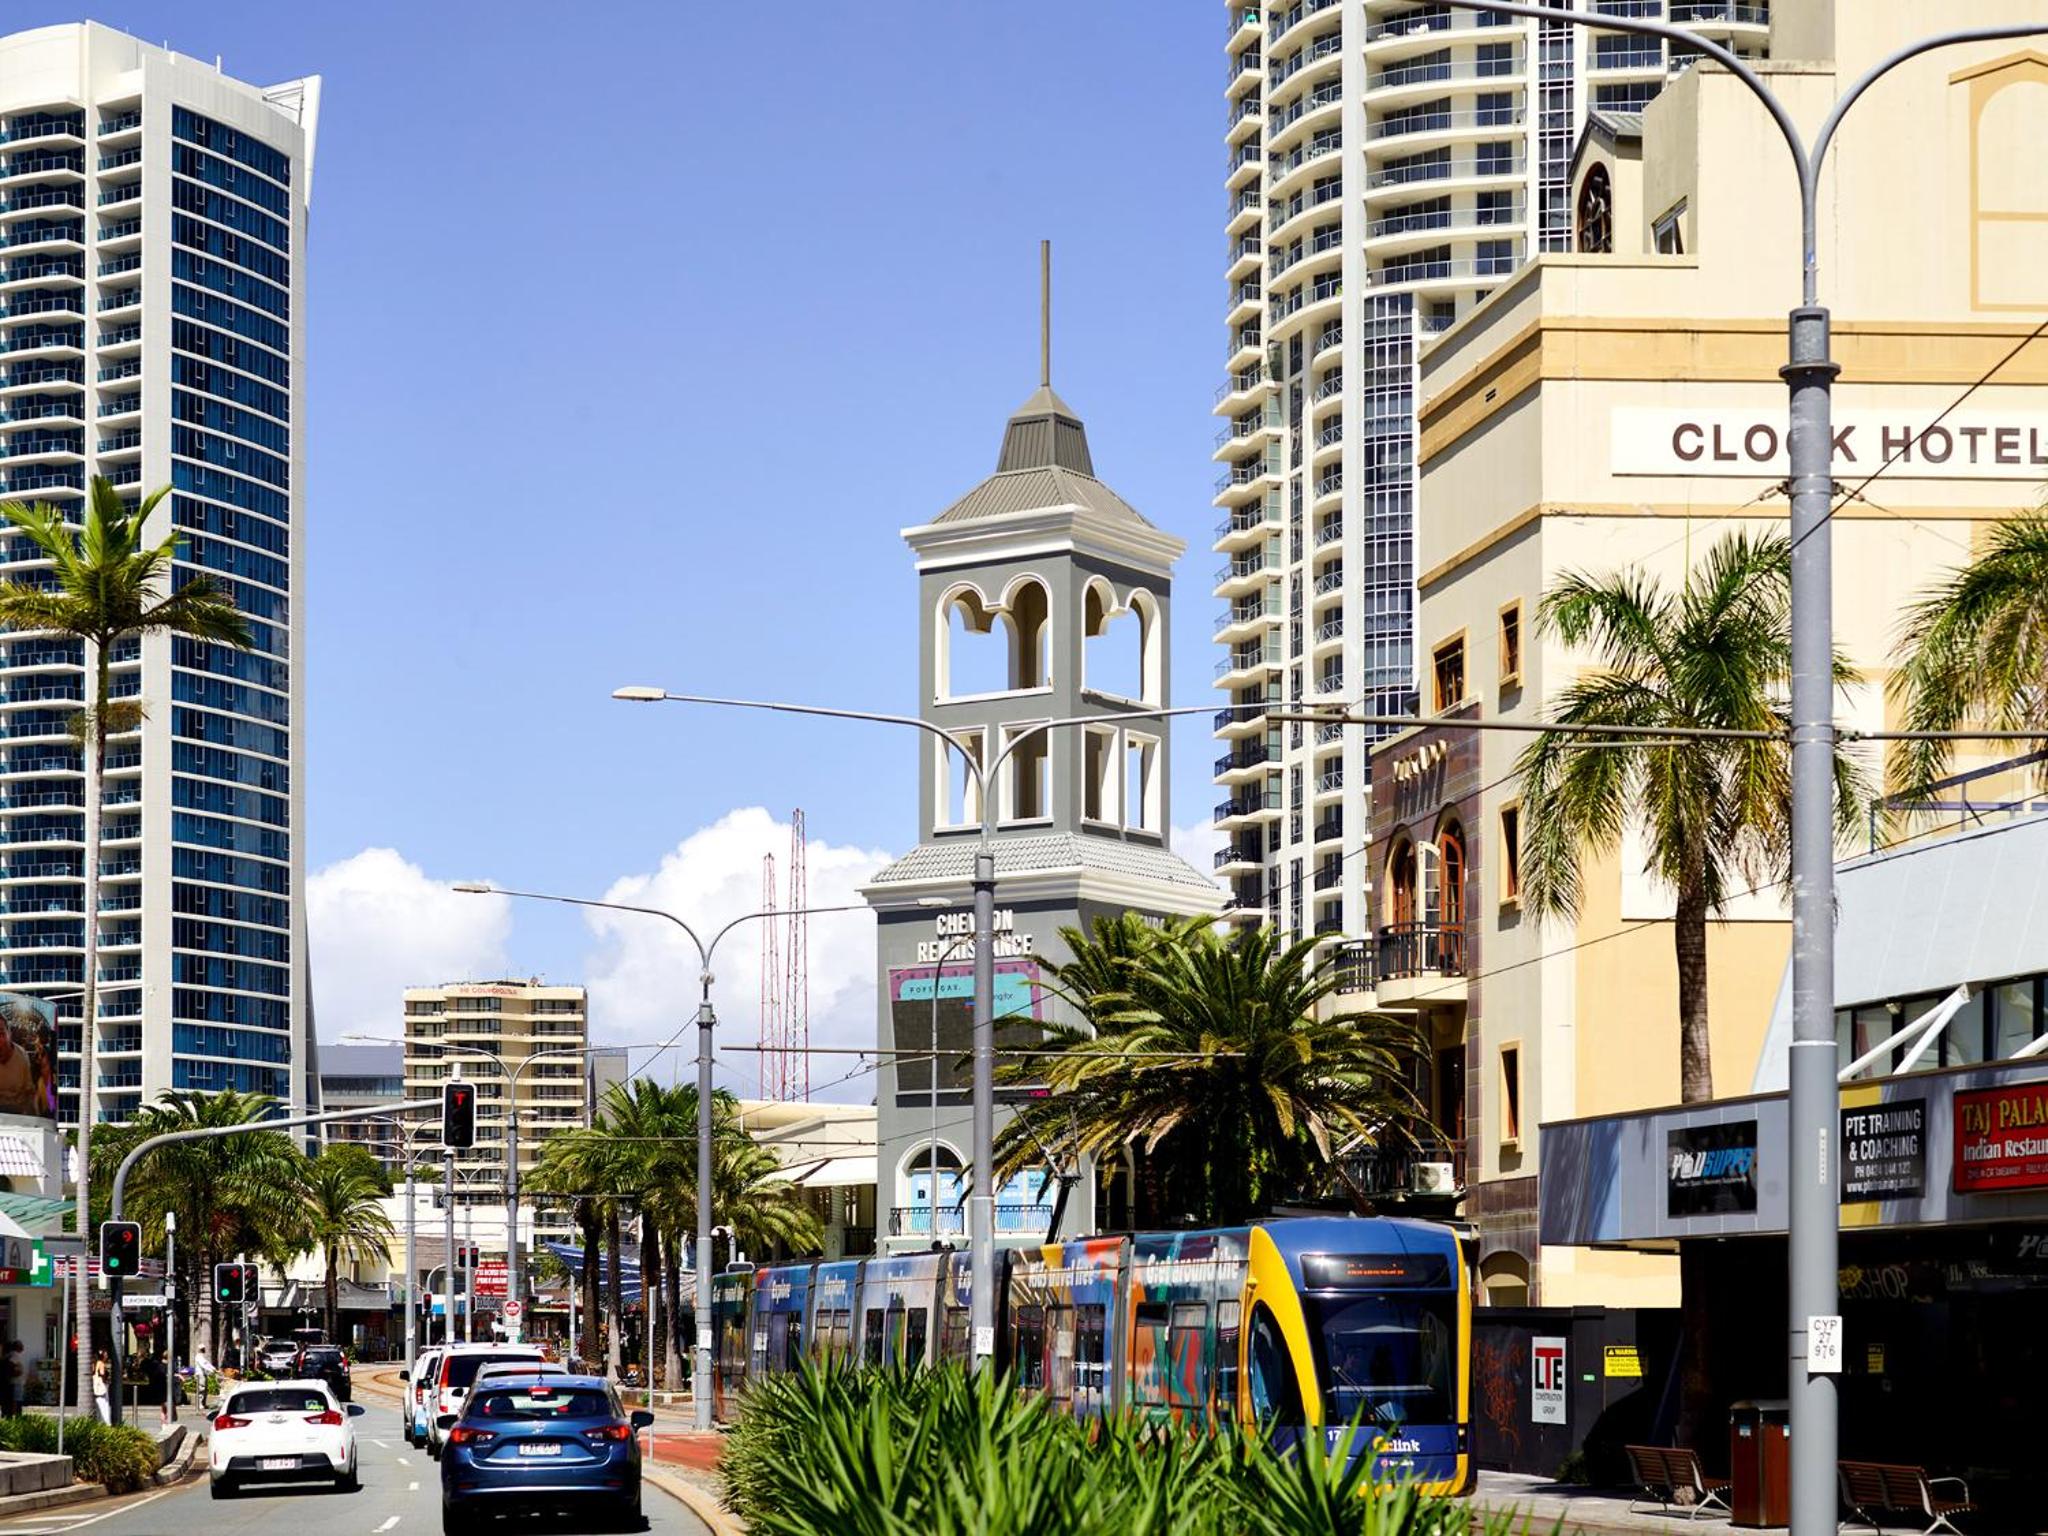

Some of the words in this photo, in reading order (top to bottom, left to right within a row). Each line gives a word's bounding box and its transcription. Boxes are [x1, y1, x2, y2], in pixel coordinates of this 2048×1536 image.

[1672, 423, 1857, 462] CLOK
[1845, 1116, 1866, 1137] PTE
[1868, 1108, 1921, 1134] TRAINING
[1962, 1102, 1991, 1135] TAJ
[1999, 1096, 2048, 1128] PALA
[1849, 1141, 1858, 1161] &
[1860, 1135, 1918, 1160] COACHING
[1963, 1138, 2002, 1161] Indian
[1814, 1319, 1837, 1331] CYP
[1327, 1430, 1342, 1441] 17
